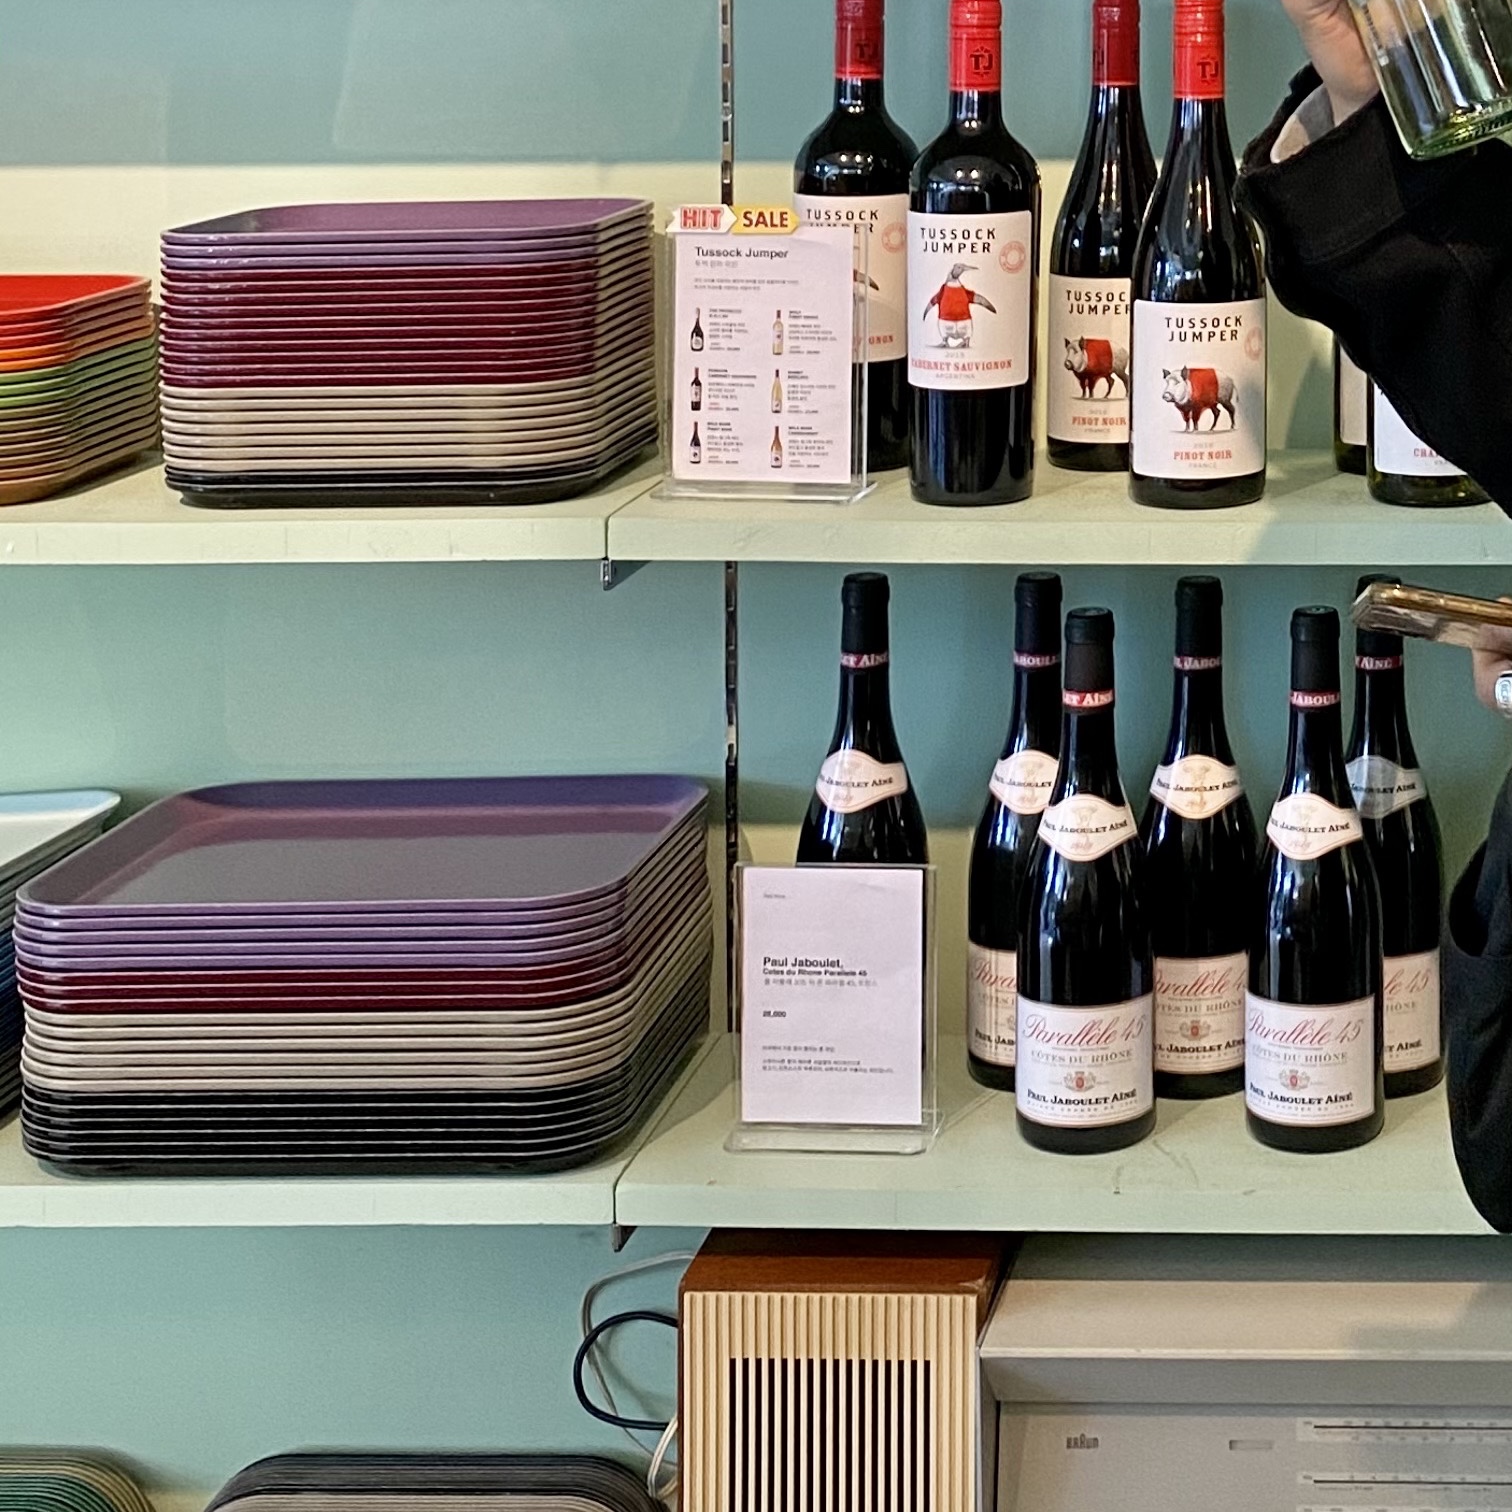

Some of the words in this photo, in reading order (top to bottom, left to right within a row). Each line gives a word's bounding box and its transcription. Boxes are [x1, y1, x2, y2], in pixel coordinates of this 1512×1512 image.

[970, 53, 993, 72] TJ
[1197, 59, 1219, 78] TJ
[680, 206, 724, 230] HIT
[743, 209, 789, 229] SALE
[806, 208, 880, 221] TUSSOCK
[920, 227, 996, 240] TUSSOCK
[695, 246, 742, 257] Tussock
[745, 247, 789, 260] Jumper
[922, 241, 992, 254] JUMPER
[1066, 289, 1127, 302] TUSSOC
[1164, 314, 1244, 329] TUSSOCK
[1168, 329, 1240, 342] JUMPER
[953, 358, 1012, 372] SAUVIGNON
[1072, 416, 1099, 426] PINOT
[1103, 416, 1127, 426] NOIR
[1173, 450, 1205, 461] PINOT
[1209, 449, 1233, 460] NOIR
[763, 956, 788, 967] Paul
[1121, 1013, 1147, 1043] 45
[1335, 1018, 1364, 1044] 45
[1027, 1088, 1048, 1103] PAUL
[1050, 1095, 1110, 1106] JABOULET
[1267, 1091, 1324, 1105] JABOULET
